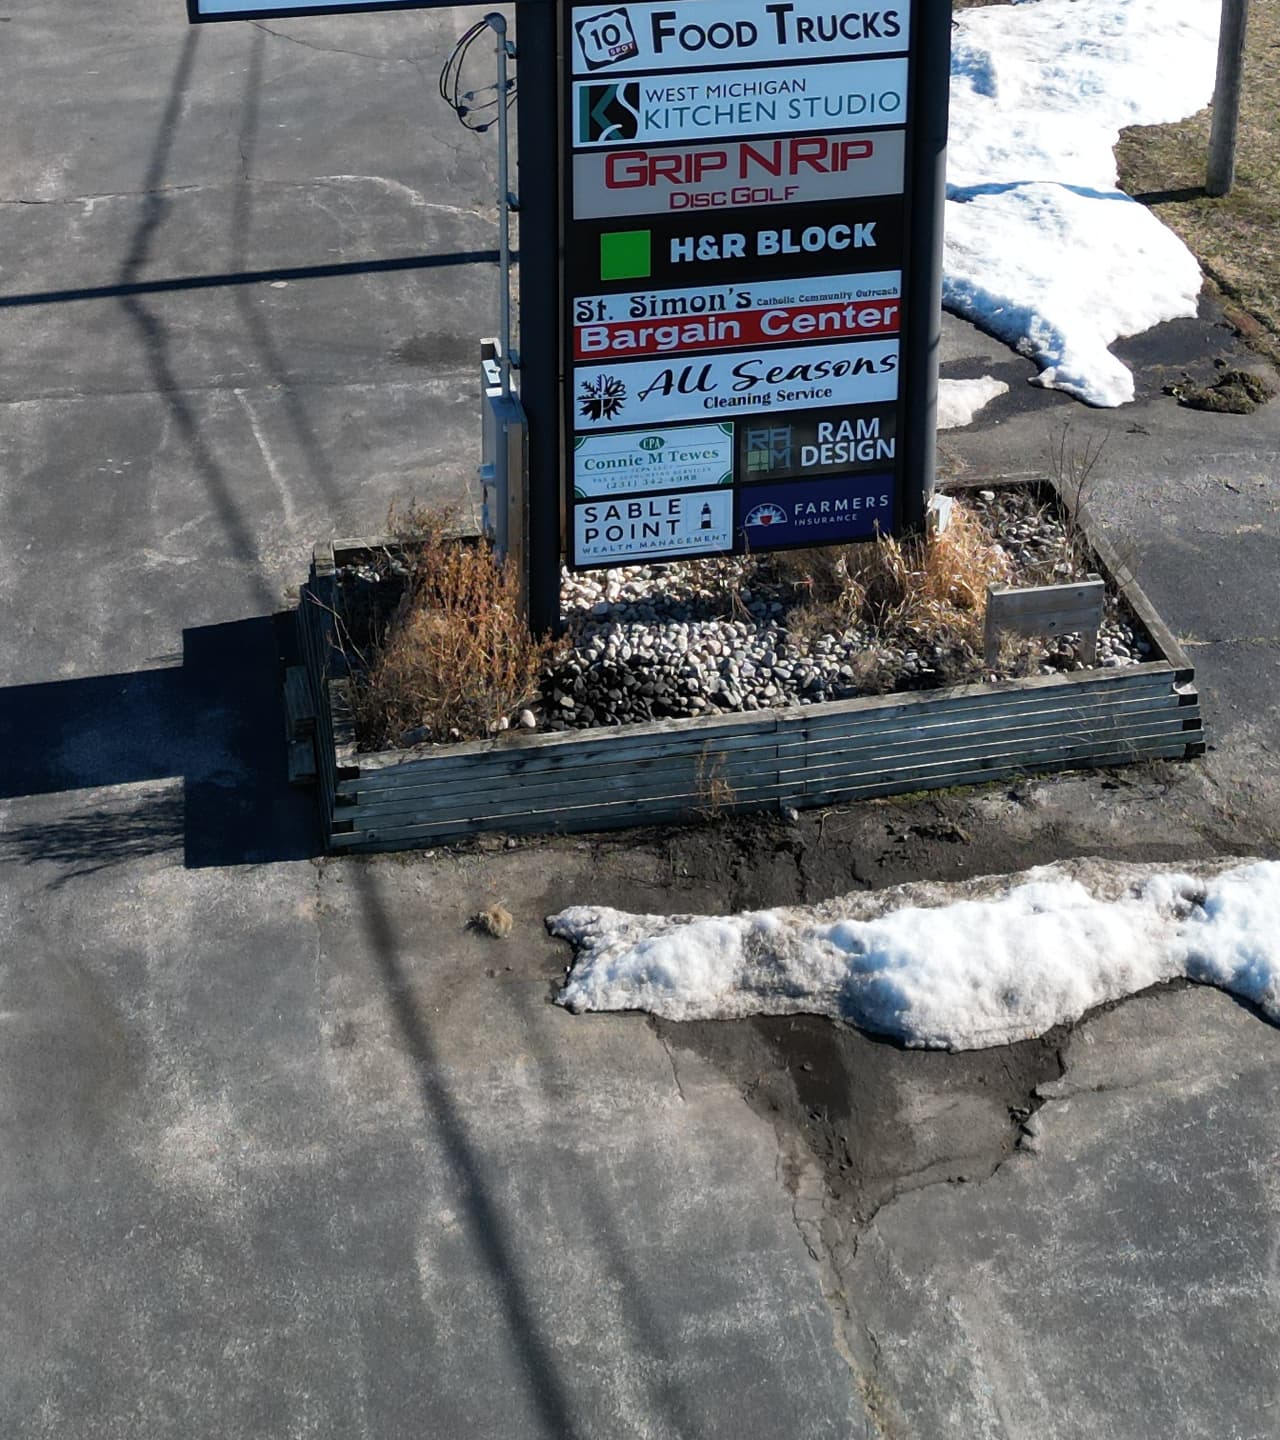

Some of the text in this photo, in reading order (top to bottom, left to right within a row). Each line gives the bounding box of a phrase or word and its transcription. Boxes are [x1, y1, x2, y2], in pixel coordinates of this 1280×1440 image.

[589, 22, 622, 51] 10
[608, 41, 635, 58] SPOT
[644, 77, 807, 103] WEST MICHIGAN
[644, 90, 901, 131] KITCHEN STUDIO
[670, 221, 877, 263] H&R BLOCK
[576, 286, 898, 323] St. Simon's Catholic Community Outreach
[580, 302, 898, 353] Bargain Center
[637, 353, 898, 402] All Seasons
[703, 386, 833, 410] Cleaning Service
[817, 417, 880, 444] RAM
[642, 438, 662, 450] CPA
[800, 437, 896, 467] DESIGN
[584, 454, 644, 471] Connie
[647, 452, 664, 464] M
[667, 448, 720, 462] Tewes
[583, 498, 682, 524] SABLE
[794, 494, 889, 516] FARMERS
[584, 519, 681, 545] POINT
[794, 513, 858, 526] INSURANCE
[582, 533, 728, 554] WEALTH MANAGEMENT
